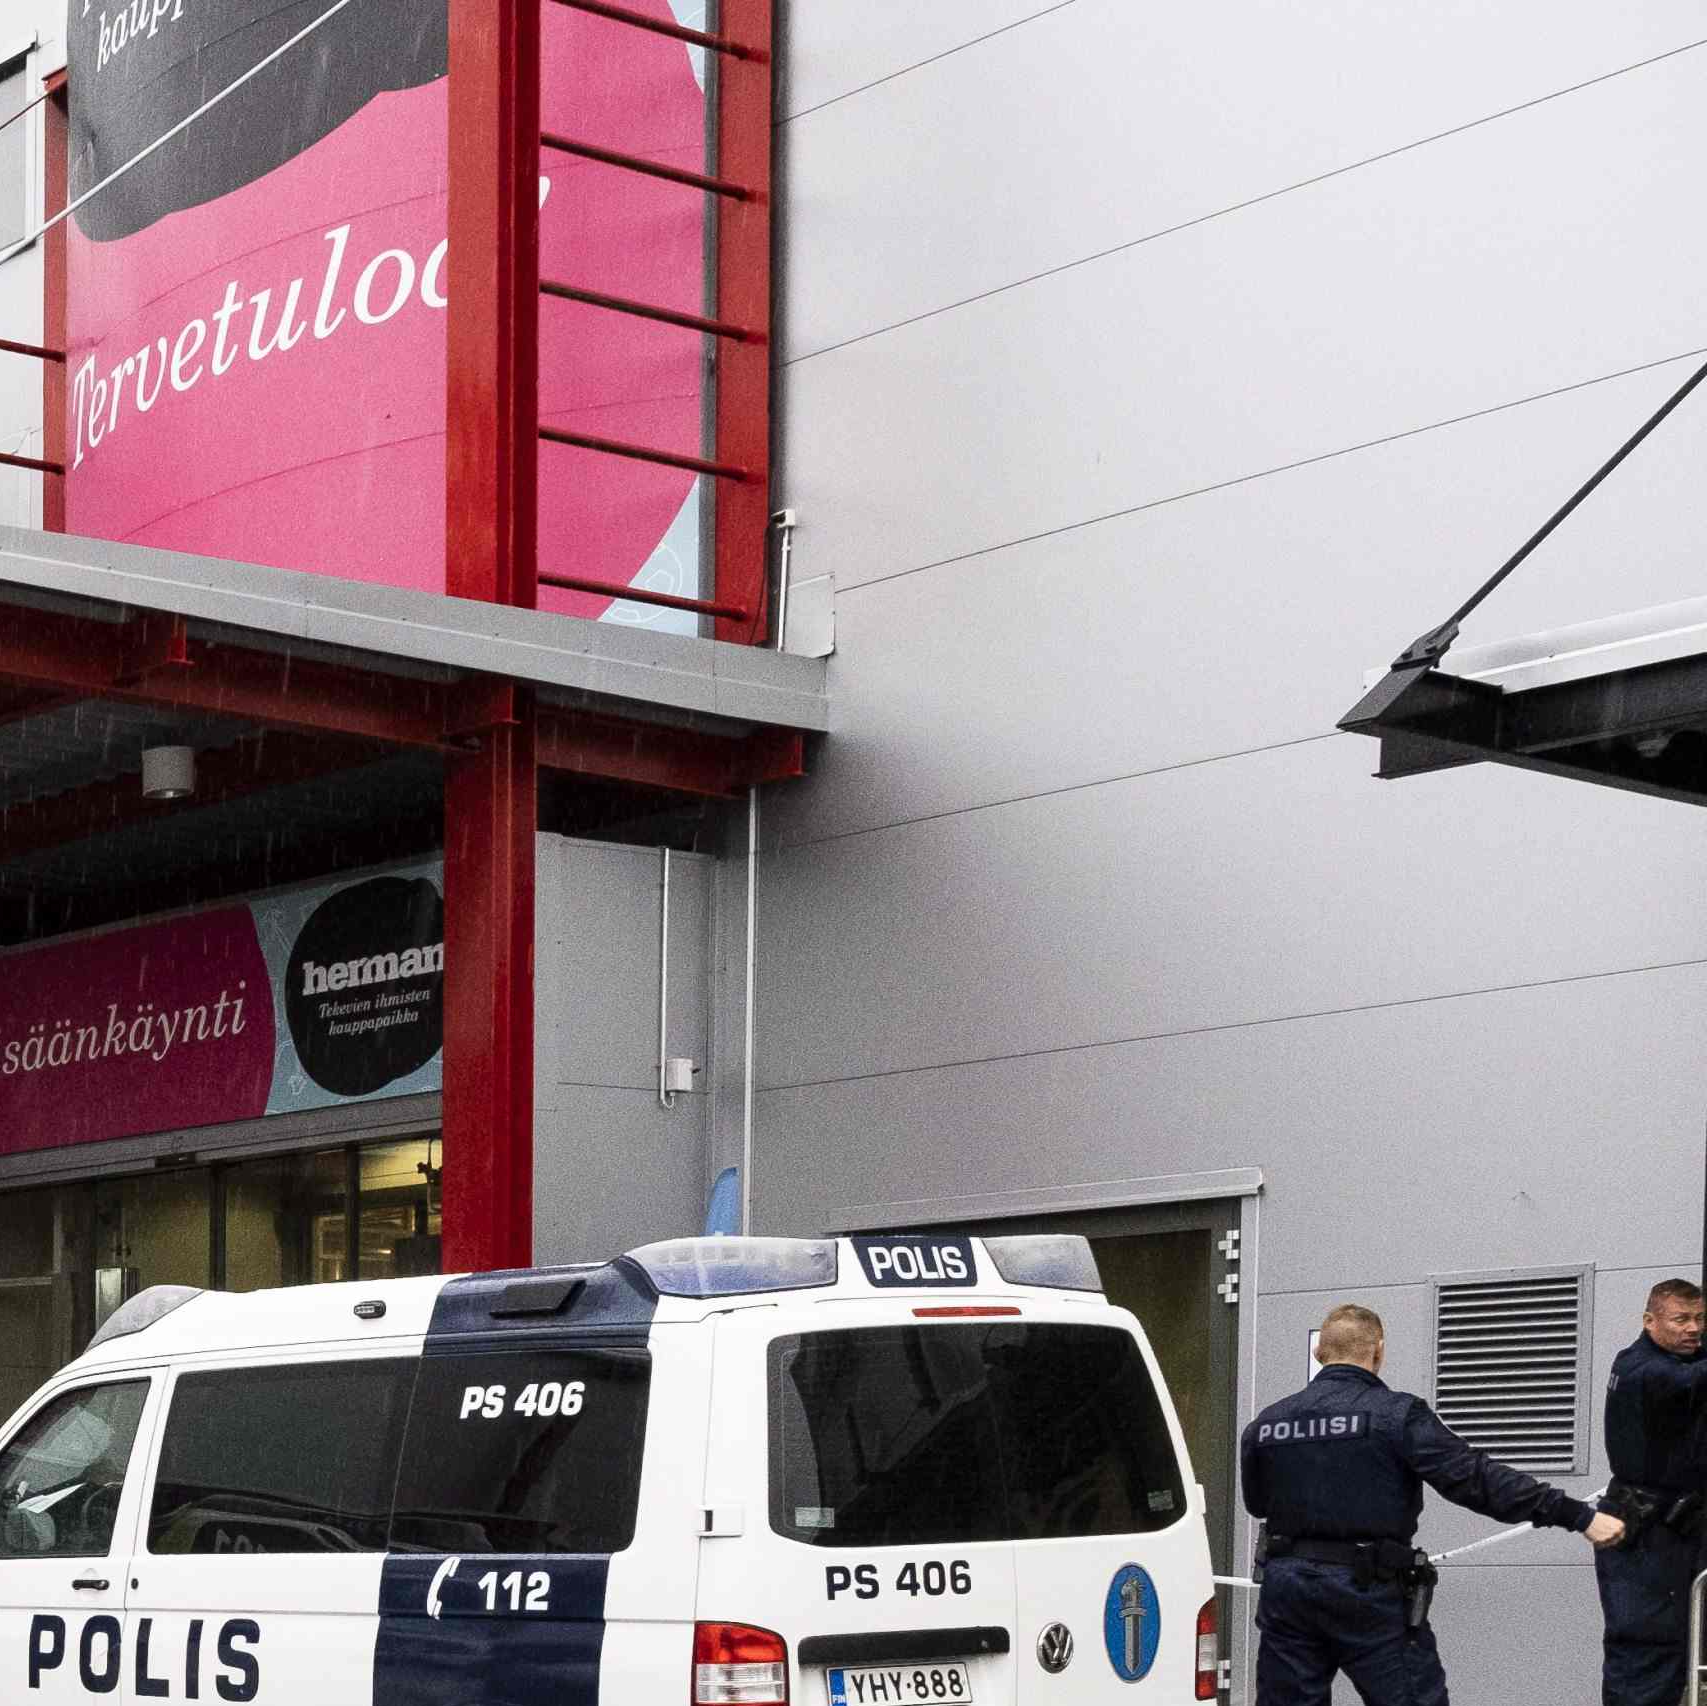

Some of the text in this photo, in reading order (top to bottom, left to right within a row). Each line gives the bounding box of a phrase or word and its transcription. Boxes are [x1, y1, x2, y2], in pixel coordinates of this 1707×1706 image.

[317, 988, 431, 1019] Tekevien ihmisten
[328, 1007, 420, 1036] kauppapaikka
[867, 1245, 969, 1280] POLIS
[458, 1380, 587, 1420] PS 406
[1257, 1415, 1360, 1443] POLIISI
[476, 1570, 552, 1612] 112
[824, 1558, 973, 1601] PS 406
[28, 1613, 262, 1703] POLIS
